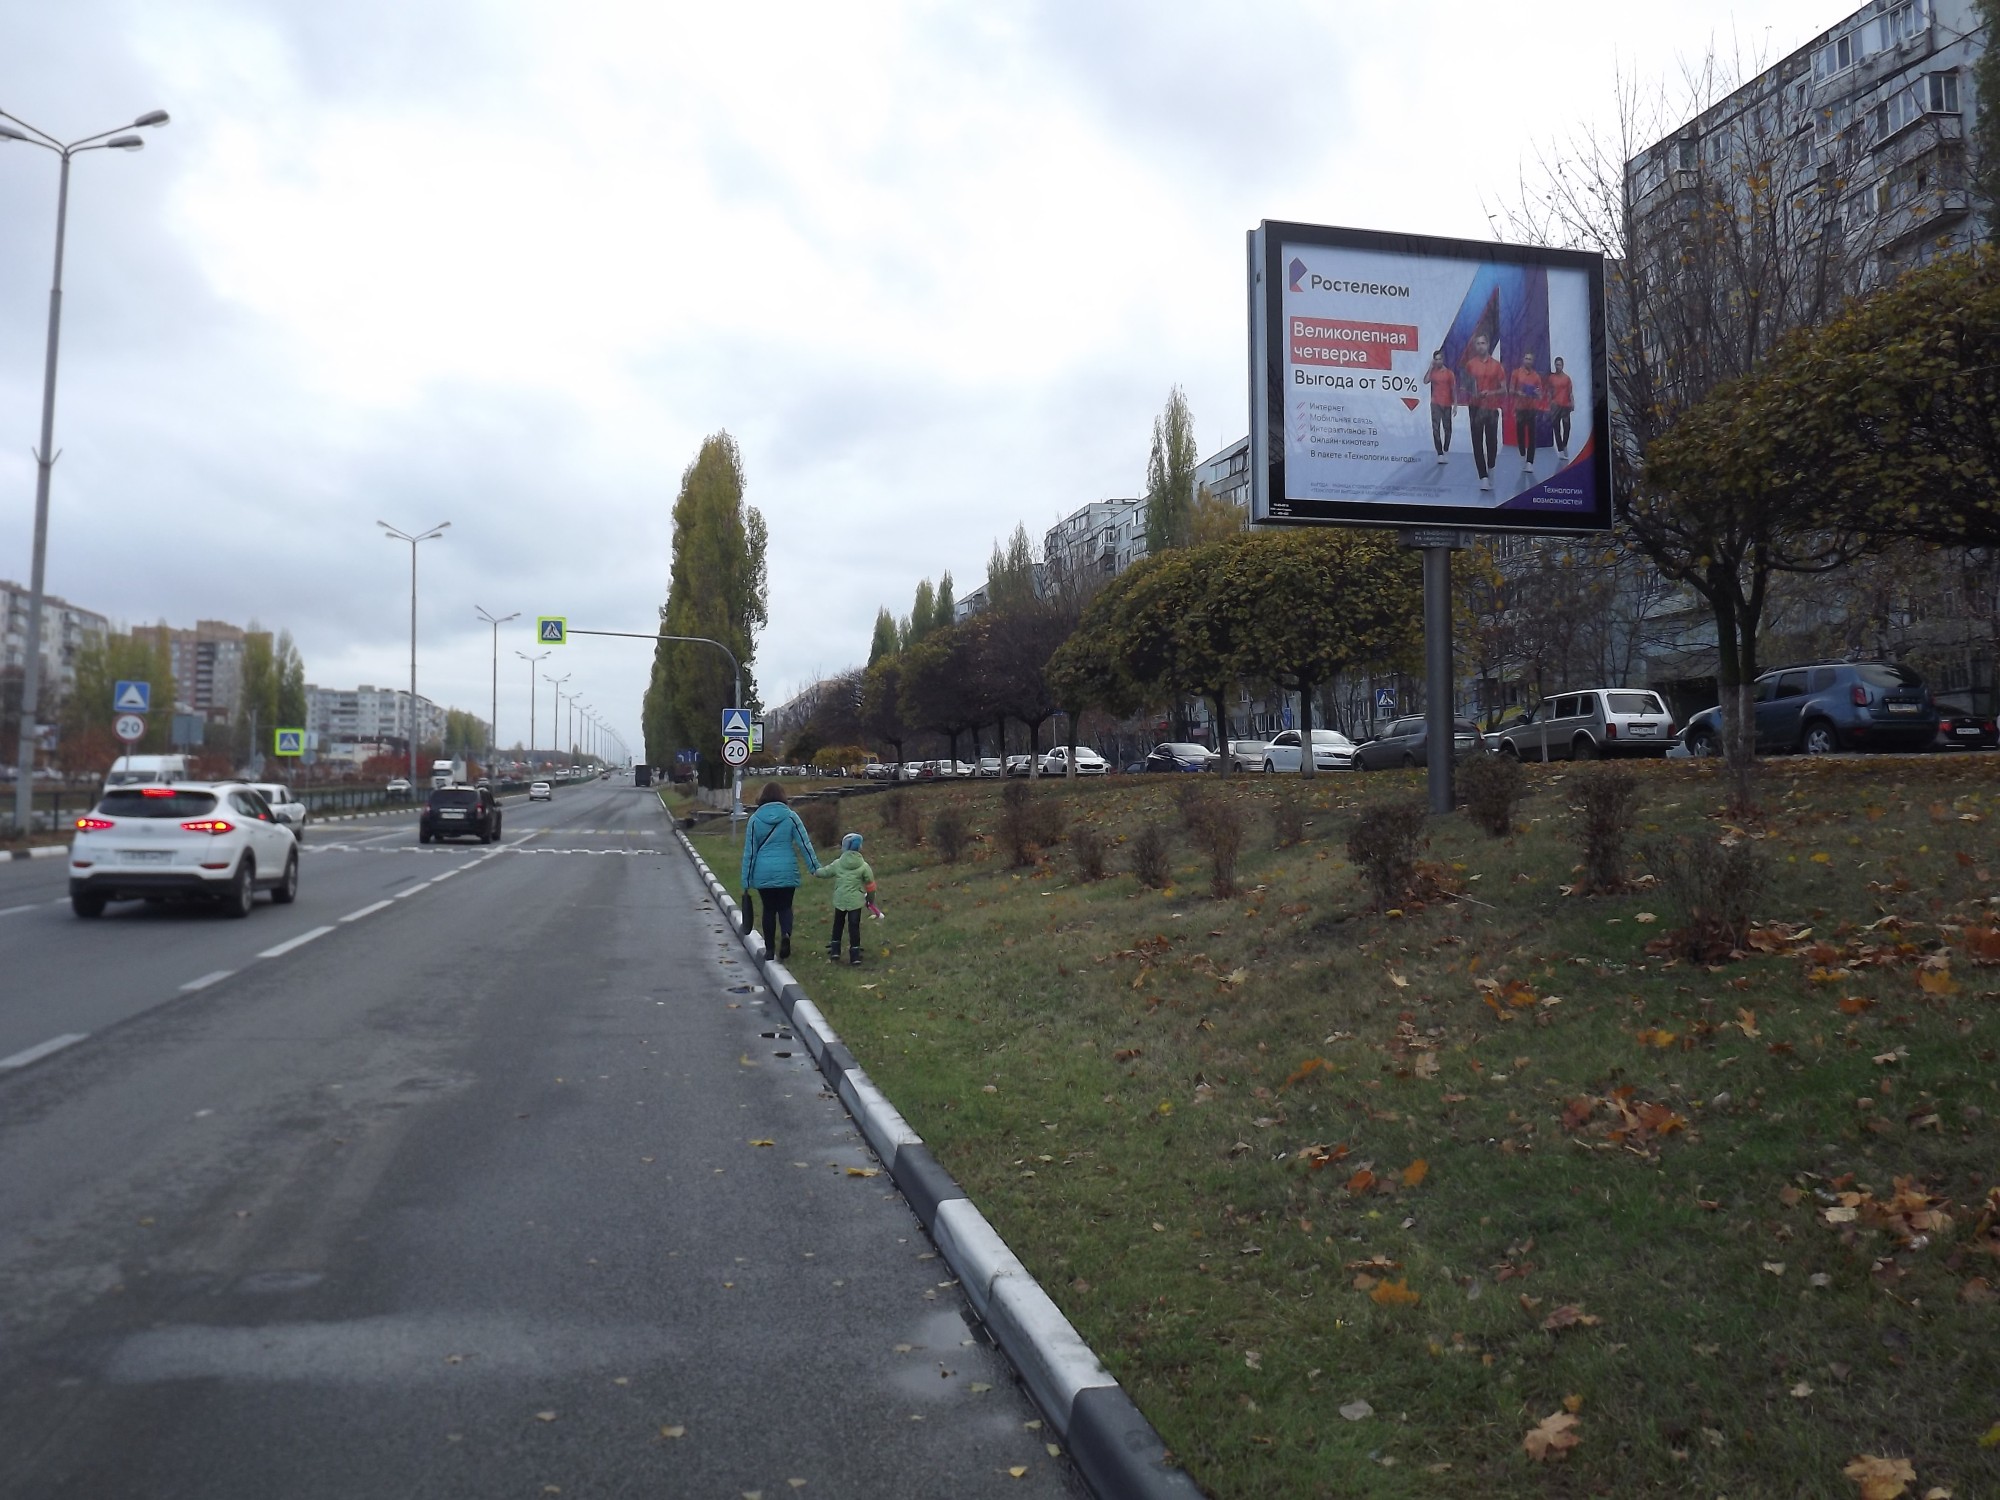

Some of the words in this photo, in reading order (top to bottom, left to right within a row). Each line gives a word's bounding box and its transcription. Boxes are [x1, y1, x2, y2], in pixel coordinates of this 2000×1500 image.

[1311, 274, 1410, 298] Ростелеком
[1293, 321, 1407, 345] Великолепная
[1294, 346, 1367, 364] четверка
[1294, 369, 1354, 390] Выгода
[1358, 377, 1377, 390] от
[1381, 375, 1418, 393] 50%
[1309, 402, 1345, 412] Интернет
[1309, 413, 1352, 423] Мобильная
[1309, 424, 1366, 435] Интерактивное
[1368, 427, 1378, 435] ТВ
[1309, 435, 1380, 448] Онлайн-кинотеатр
[1310, 449, 1316, 458] В
[1317, 451, 1343, 460] пакете
[1344, 451, 1389, 462] «Технологии
[1543, 485, 1583, 495] Технологии
[1532, 496, 1583, 506] возможностей
[120, 720, 140, 734] 20
[727, 746, 745, 757] 20
